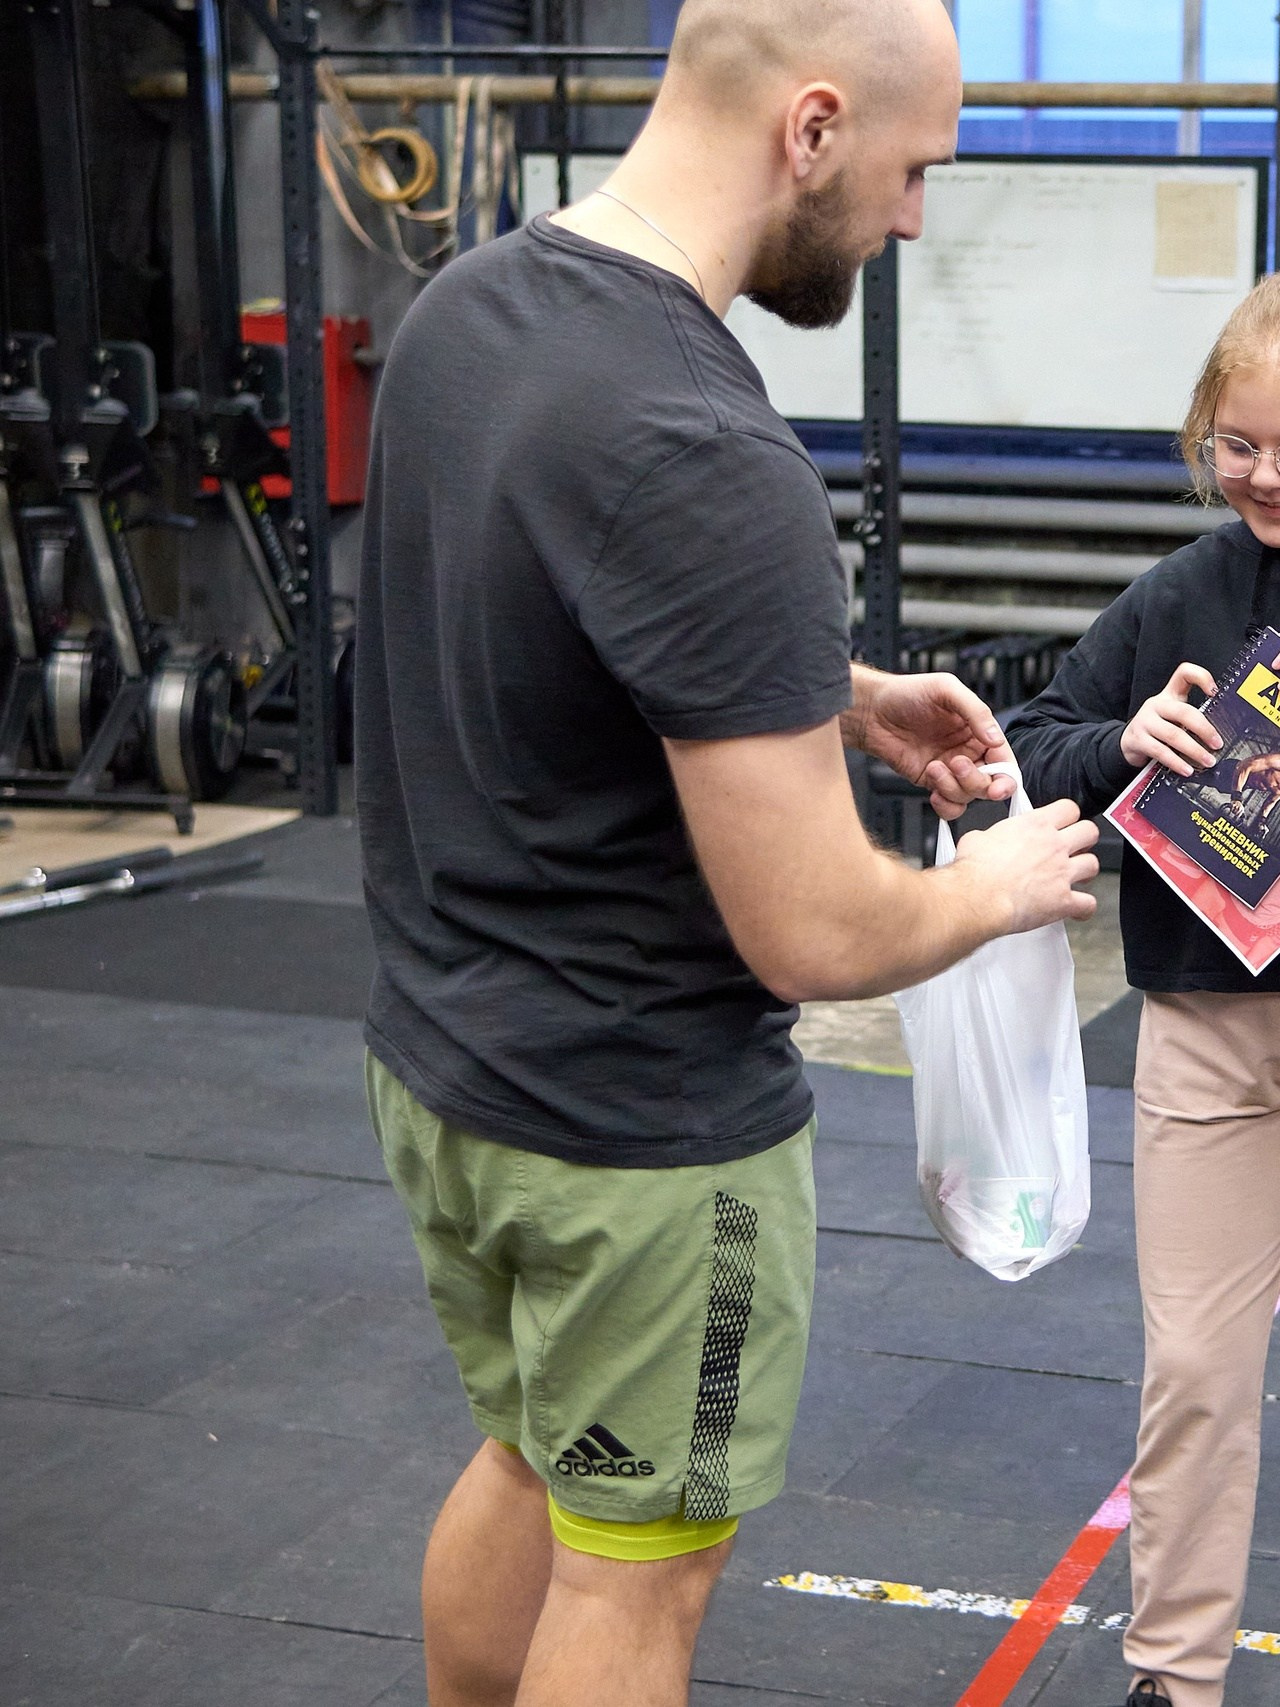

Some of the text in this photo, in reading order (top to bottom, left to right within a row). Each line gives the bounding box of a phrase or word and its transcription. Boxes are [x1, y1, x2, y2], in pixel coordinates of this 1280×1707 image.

[1190, 811, 1261, 870] функциональных
[1199, 829, 1256, 879] тренировок
[1213, 817, 1270, 863] ДНЕВНИК
[555, 1458, 656, 1477] adidas
